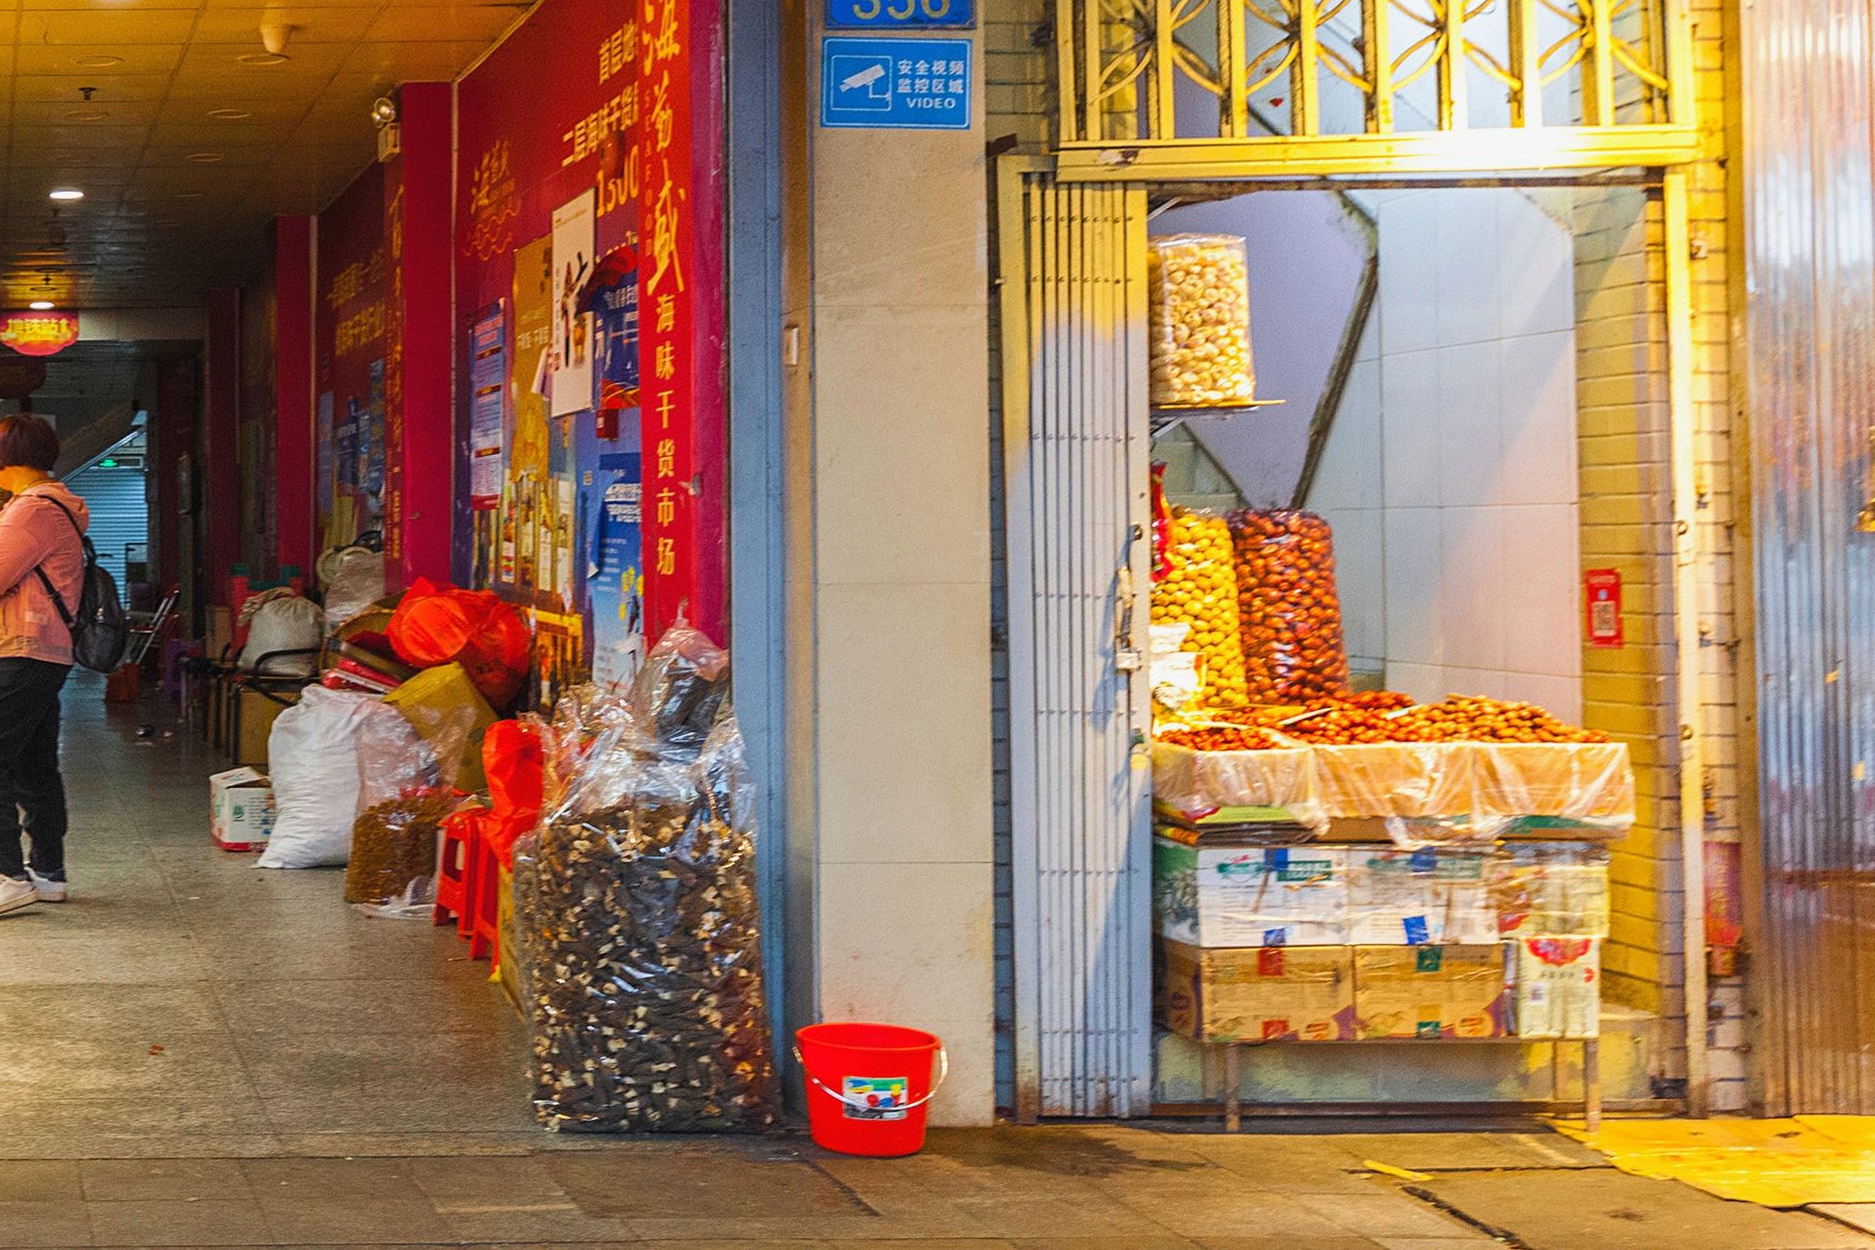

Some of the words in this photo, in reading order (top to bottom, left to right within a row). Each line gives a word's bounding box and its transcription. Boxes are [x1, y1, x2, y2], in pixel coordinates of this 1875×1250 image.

[599, 18, 639, 85] 首层地
[897, 59, 965, 76] 安全视频
[896, 78, 965, 95] 监控区域
[905, 97, 957, 110] VIDEO
[655, 293, 676, 578] 海味干货市场
